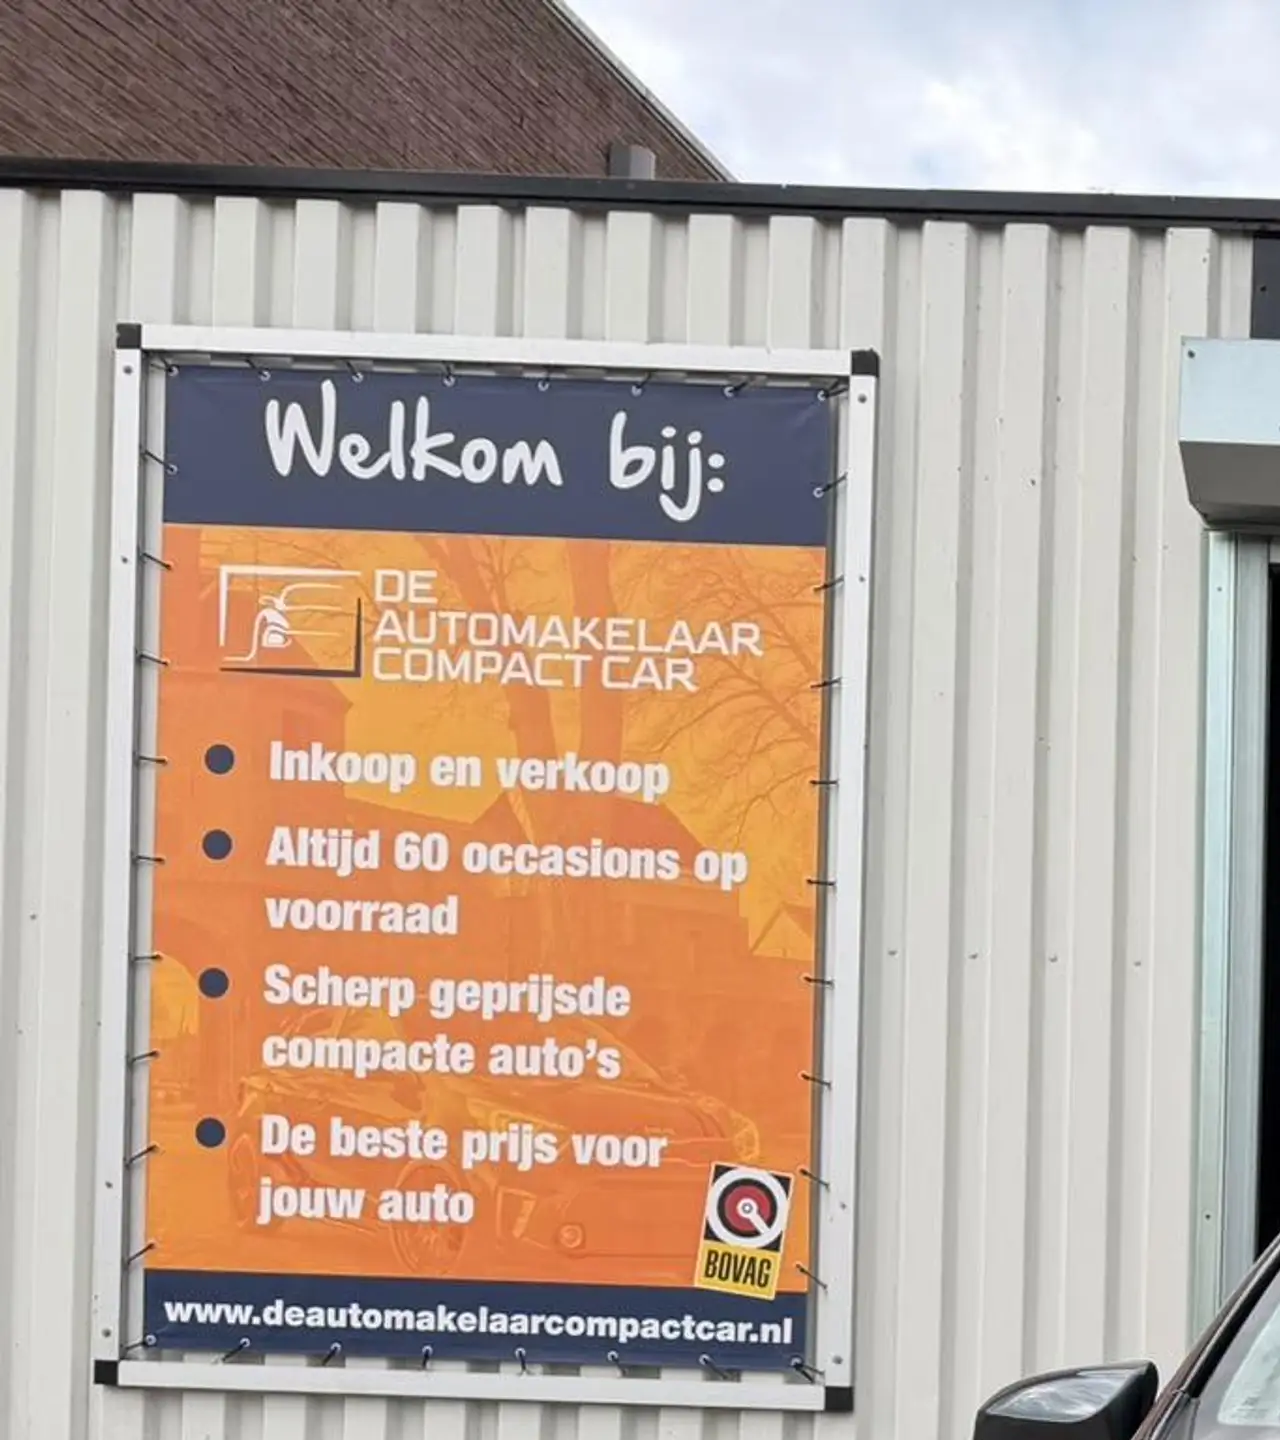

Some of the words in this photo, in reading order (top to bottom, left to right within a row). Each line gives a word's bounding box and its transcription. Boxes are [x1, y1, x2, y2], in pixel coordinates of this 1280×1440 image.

[265, 380, 563, 486] Welkom
[608, 411, 725, 521] bij:
[375, 569, 438, 603] DE
[373, 611, 763, 657] AUTOMAKELAAR
[373, 647, 592, 690] COMPACT
[601, 656, 698, 692] CAR
[270, 741, 415, 790] Inkoop
[430, 753, 481, 787] en
[496, 755, 670, 804] verkoop
[266, 827, 379, 876] Altijd
[394, 833, 448, 872] 60
[462, 839, 680, 880] occasions
[694, 850, 747, 890] op
[265, 896, 458, 935] voorraad
[263, 964, 415, 1014] Scherp
[429, 975, 631, 1019] geprijsde
[262, 1035, 475, 1077] compacte
[261, 1115, 316, 1156] De
[330, 1117, 447, 1159] beste
[462, 1124, 557, 1172] prijs
[572, 1131, 668, 1168] voor
[256, 1178, 365, 1225] jouw
[378, 1182, 475, 1224] auto
[704, 1249, 772, 1288] BOVAG
[164, 1299, 793, 1345] www.deautomakelaarcompactcar.nl
